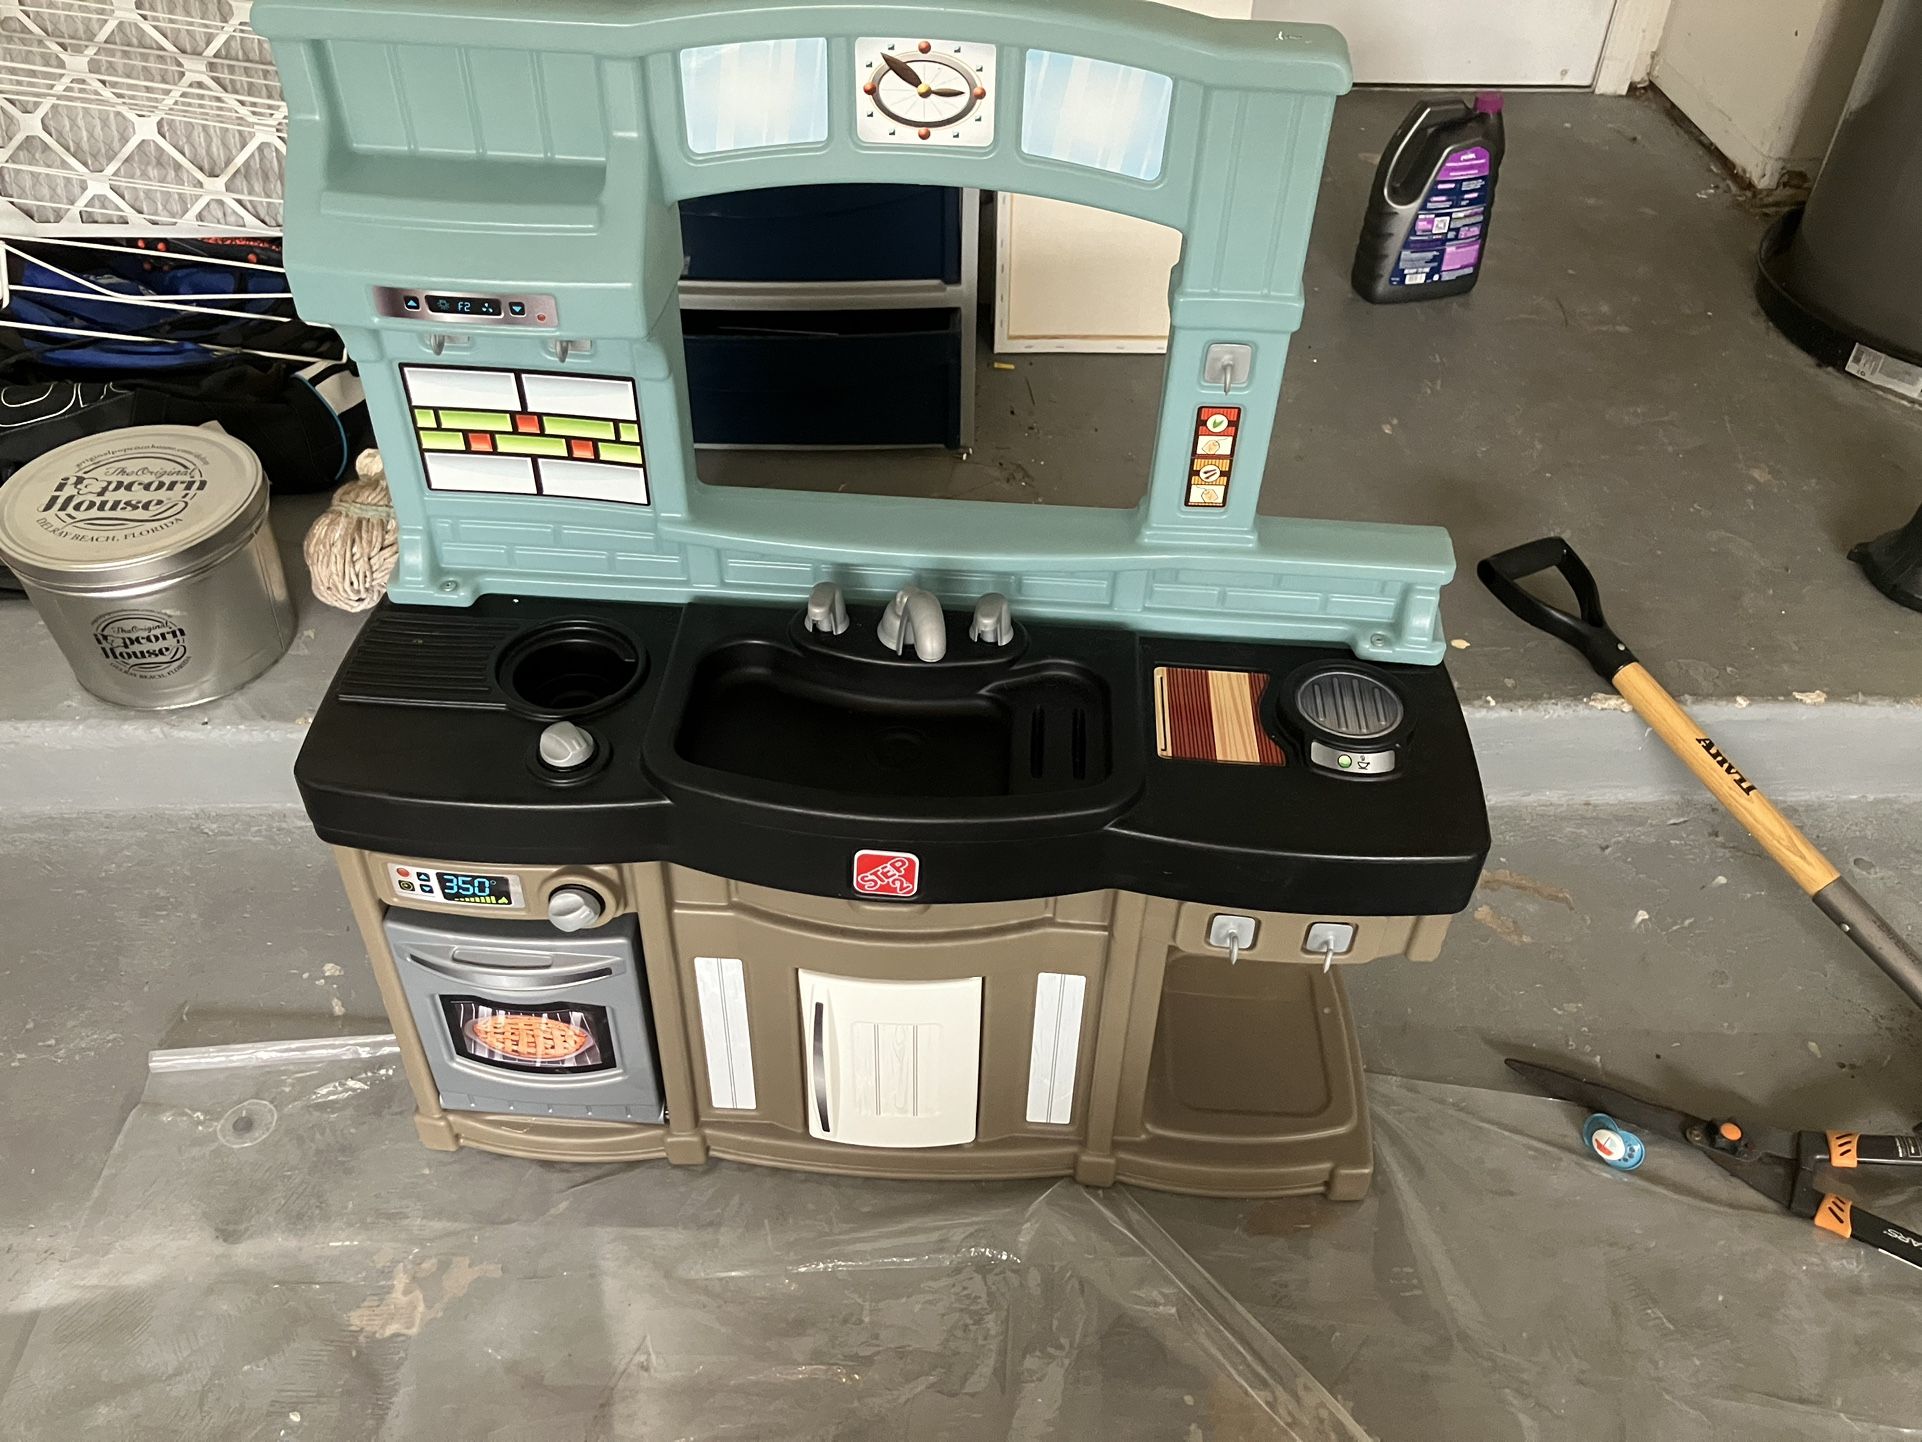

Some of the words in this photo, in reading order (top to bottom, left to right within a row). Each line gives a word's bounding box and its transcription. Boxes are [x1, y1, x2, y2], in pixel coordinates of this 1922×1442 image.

[458, 301, 471, 312] F2
[37, 494, 168, 513] House
[101, 646, 172, 660] House
[858, 857, 909, 891] STEP
